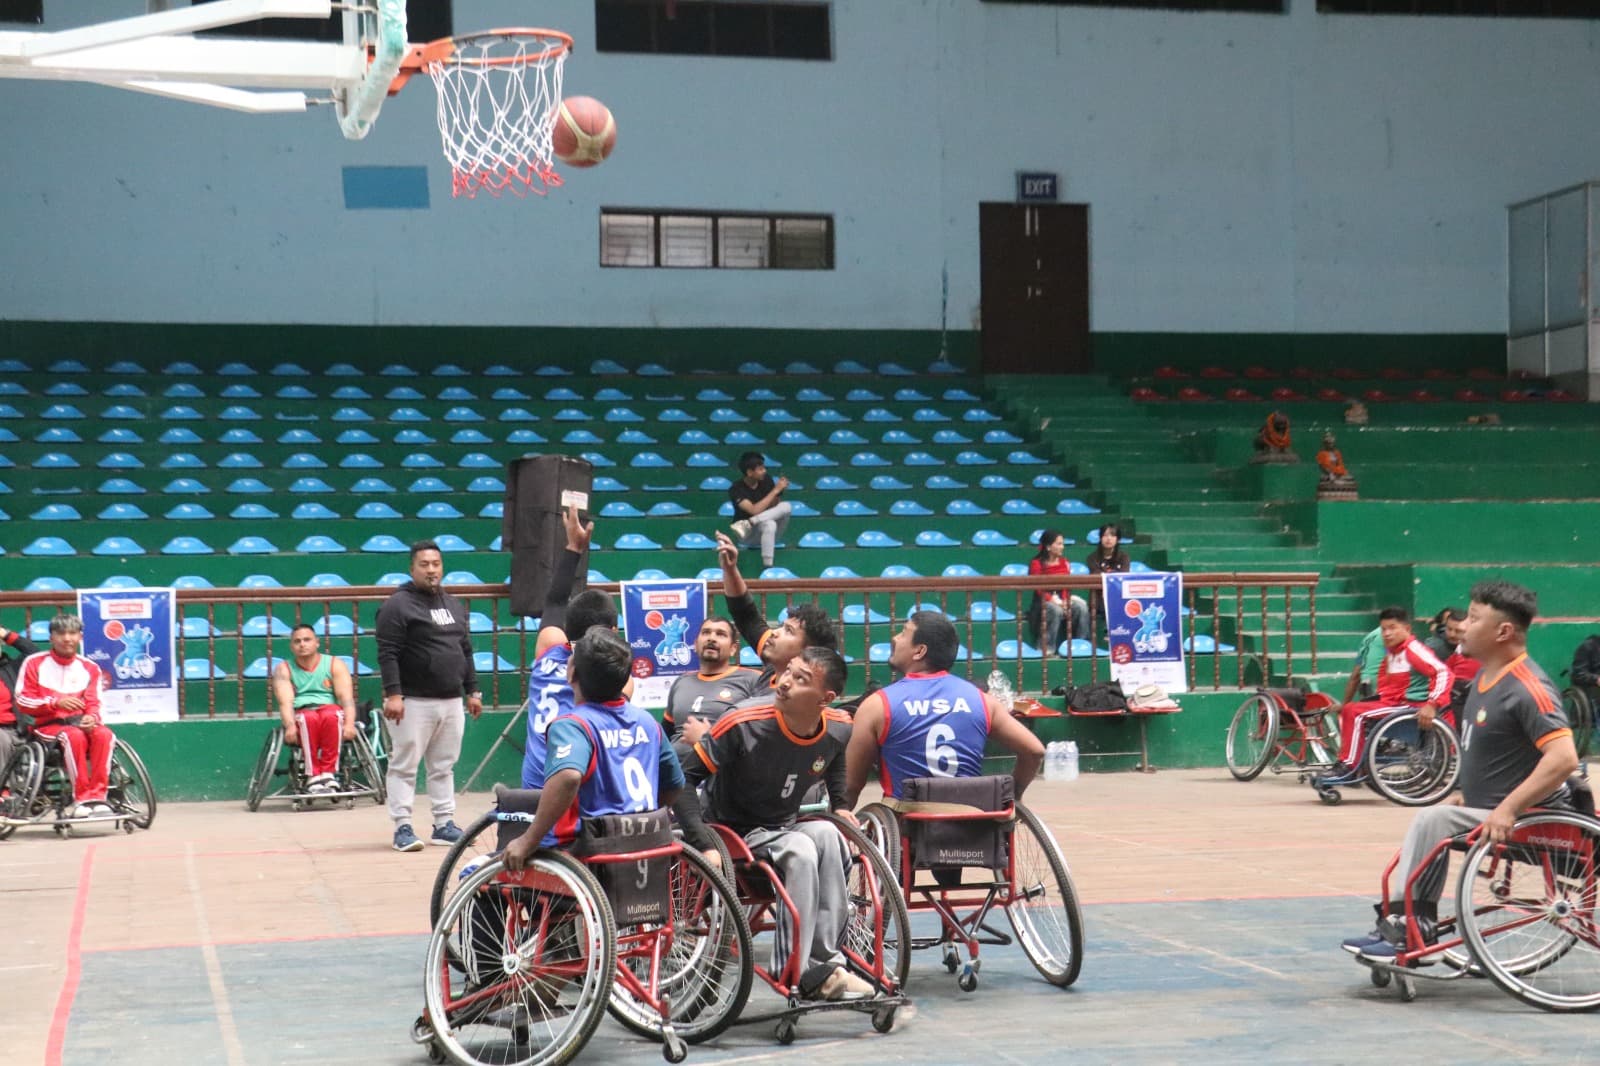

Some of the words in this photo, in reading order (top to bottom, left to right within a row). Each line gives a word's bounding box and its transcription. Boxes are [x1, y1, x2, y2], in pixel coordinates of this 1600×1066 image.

[1025, 179, 1051, 195] EXIT
[540, 657, 568, 677] WS
[534, 683, 565, 734] 5
[692, 696, 704, 712] 4
[904, 698, 971, 715] WSA
[600, 726, 649, 749] WSA
[925, 723, 959, 778] 6
[623, 756, 654, 811] 9
[781, 774, 798, 798] 5
[939, 849, 984, 859] Multisport
[636, 859, 649, 889] 9
[627, 902, 660, 914] Multisport
